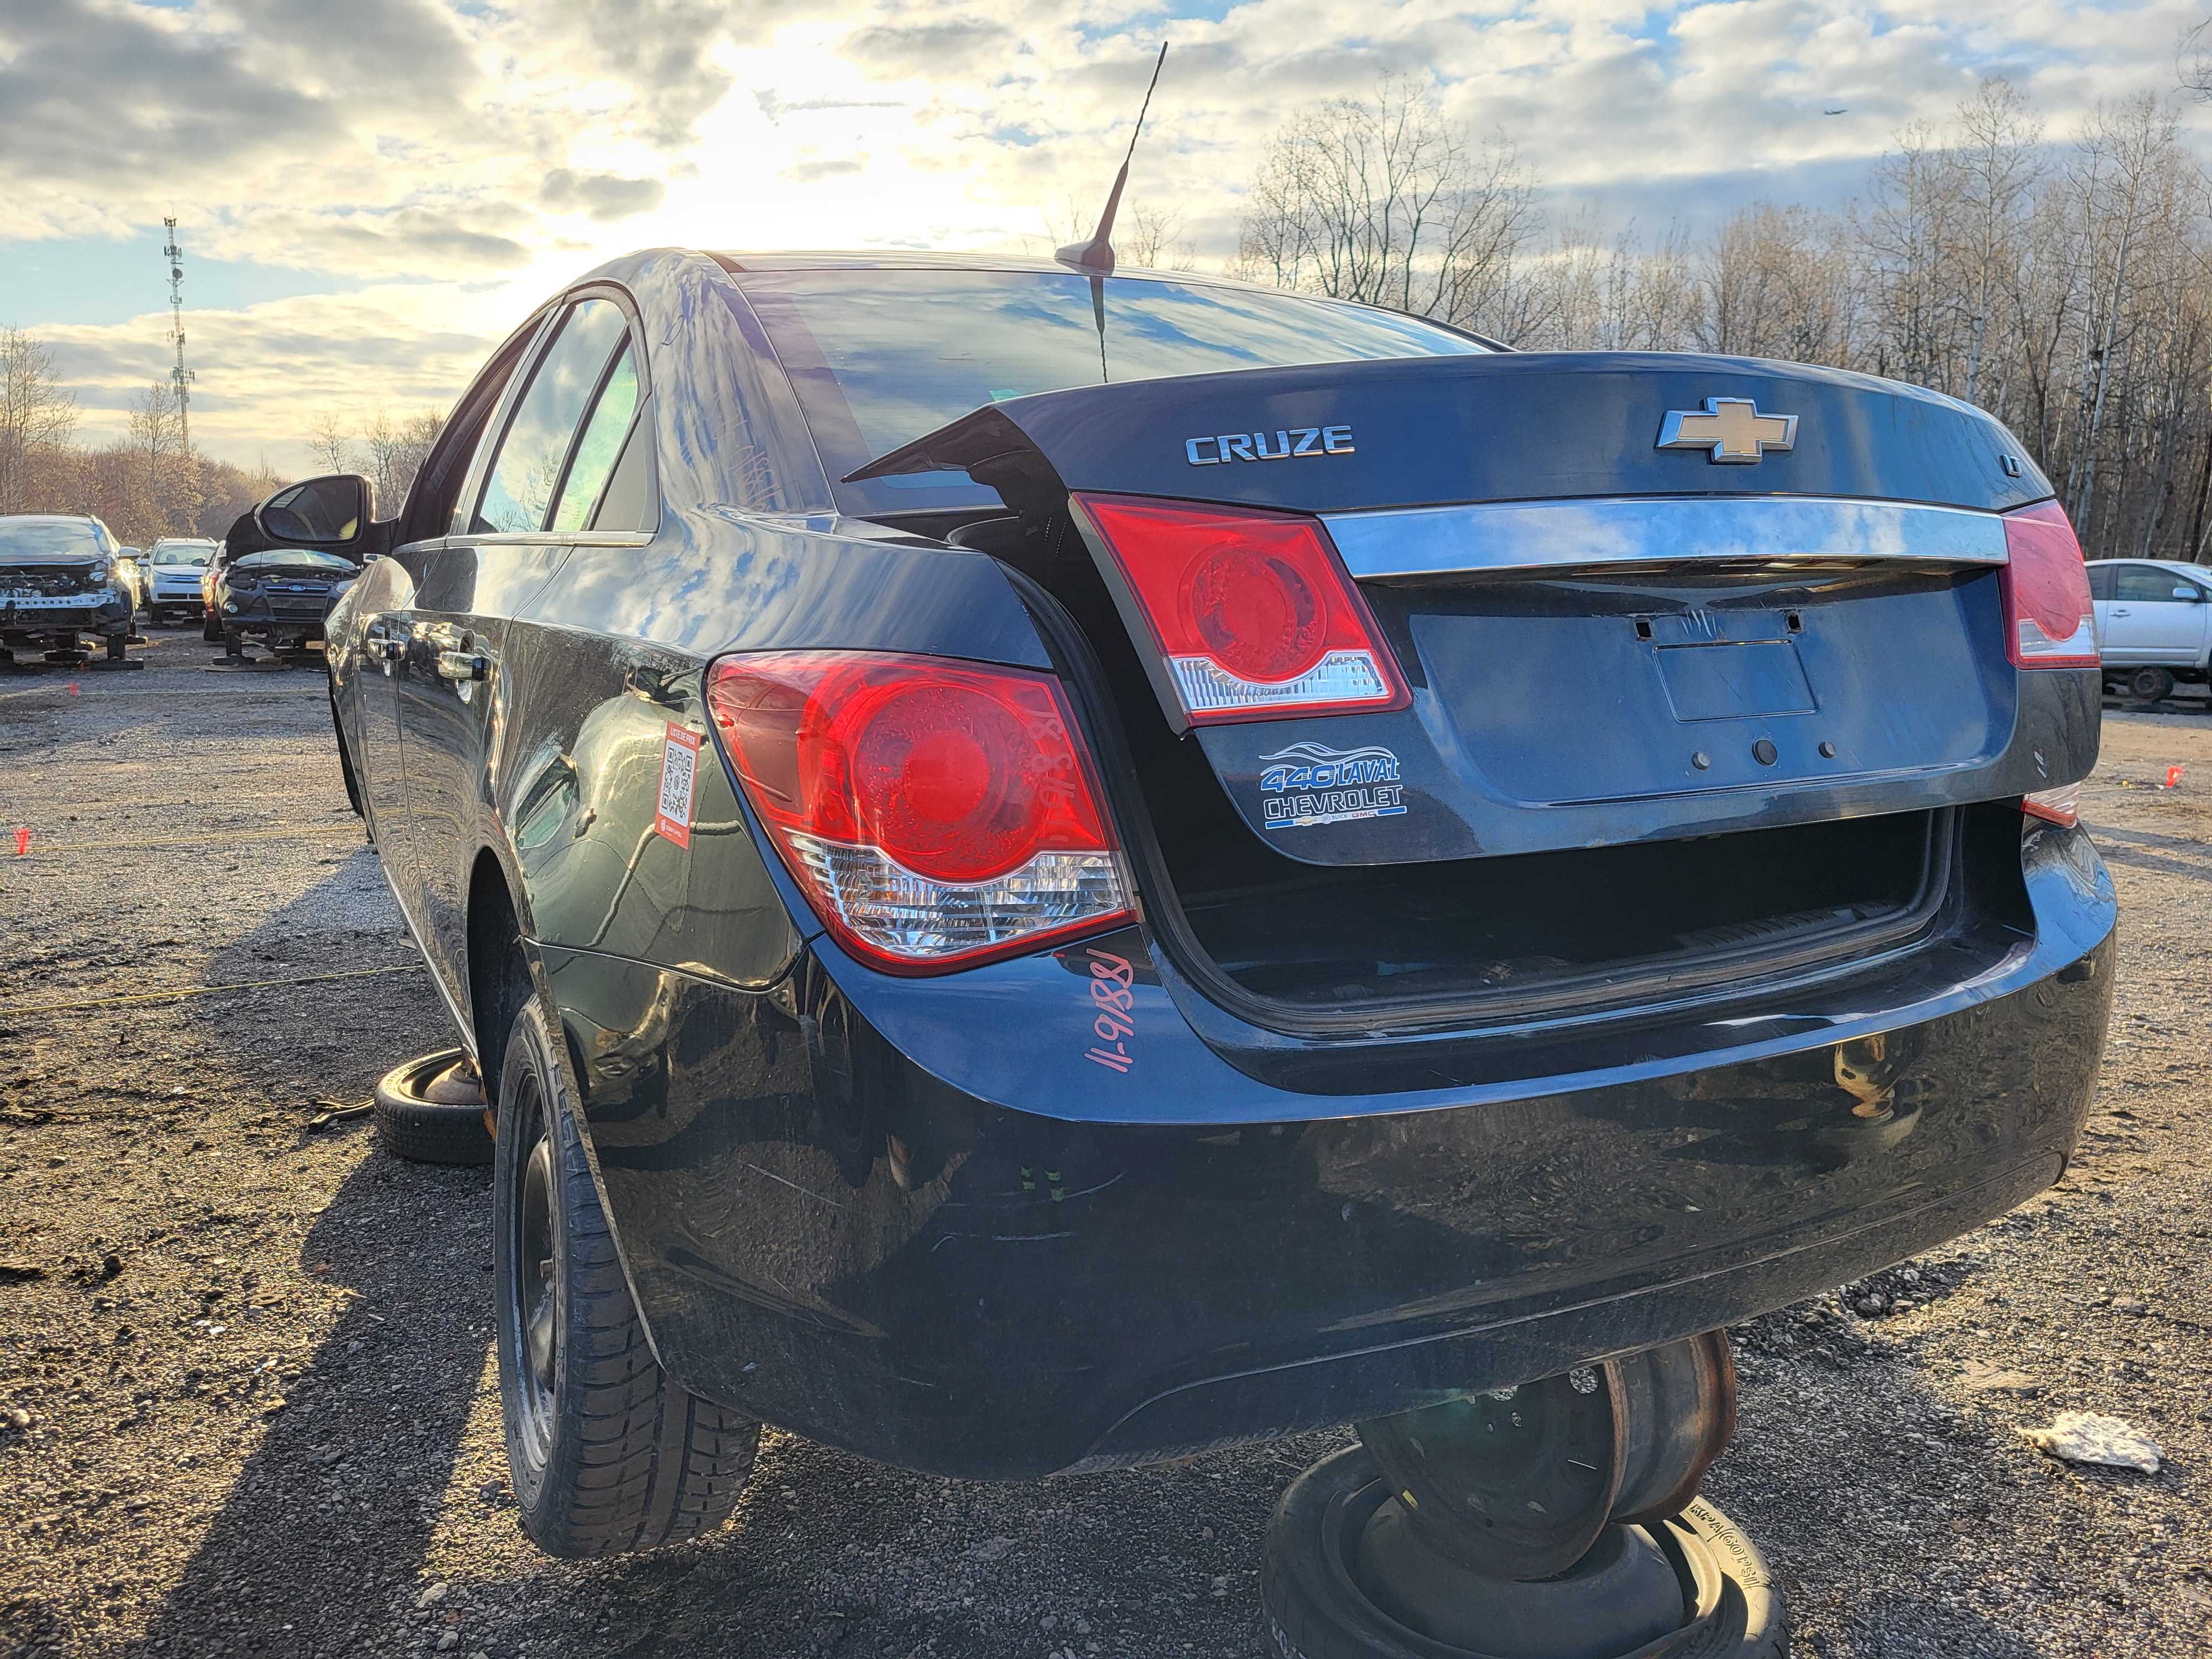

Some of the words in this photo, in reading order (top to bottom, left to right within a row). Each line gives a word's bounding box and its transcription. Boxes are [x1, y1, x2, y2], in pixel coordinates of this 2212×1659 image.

[1185, 425, 1355, 466] CRUZE
[1260, 764, 1336, 793] 440
[1337, 757, 1400, 786] LAVAL
[1264, 785, 1403, 820] CHEVROLET
